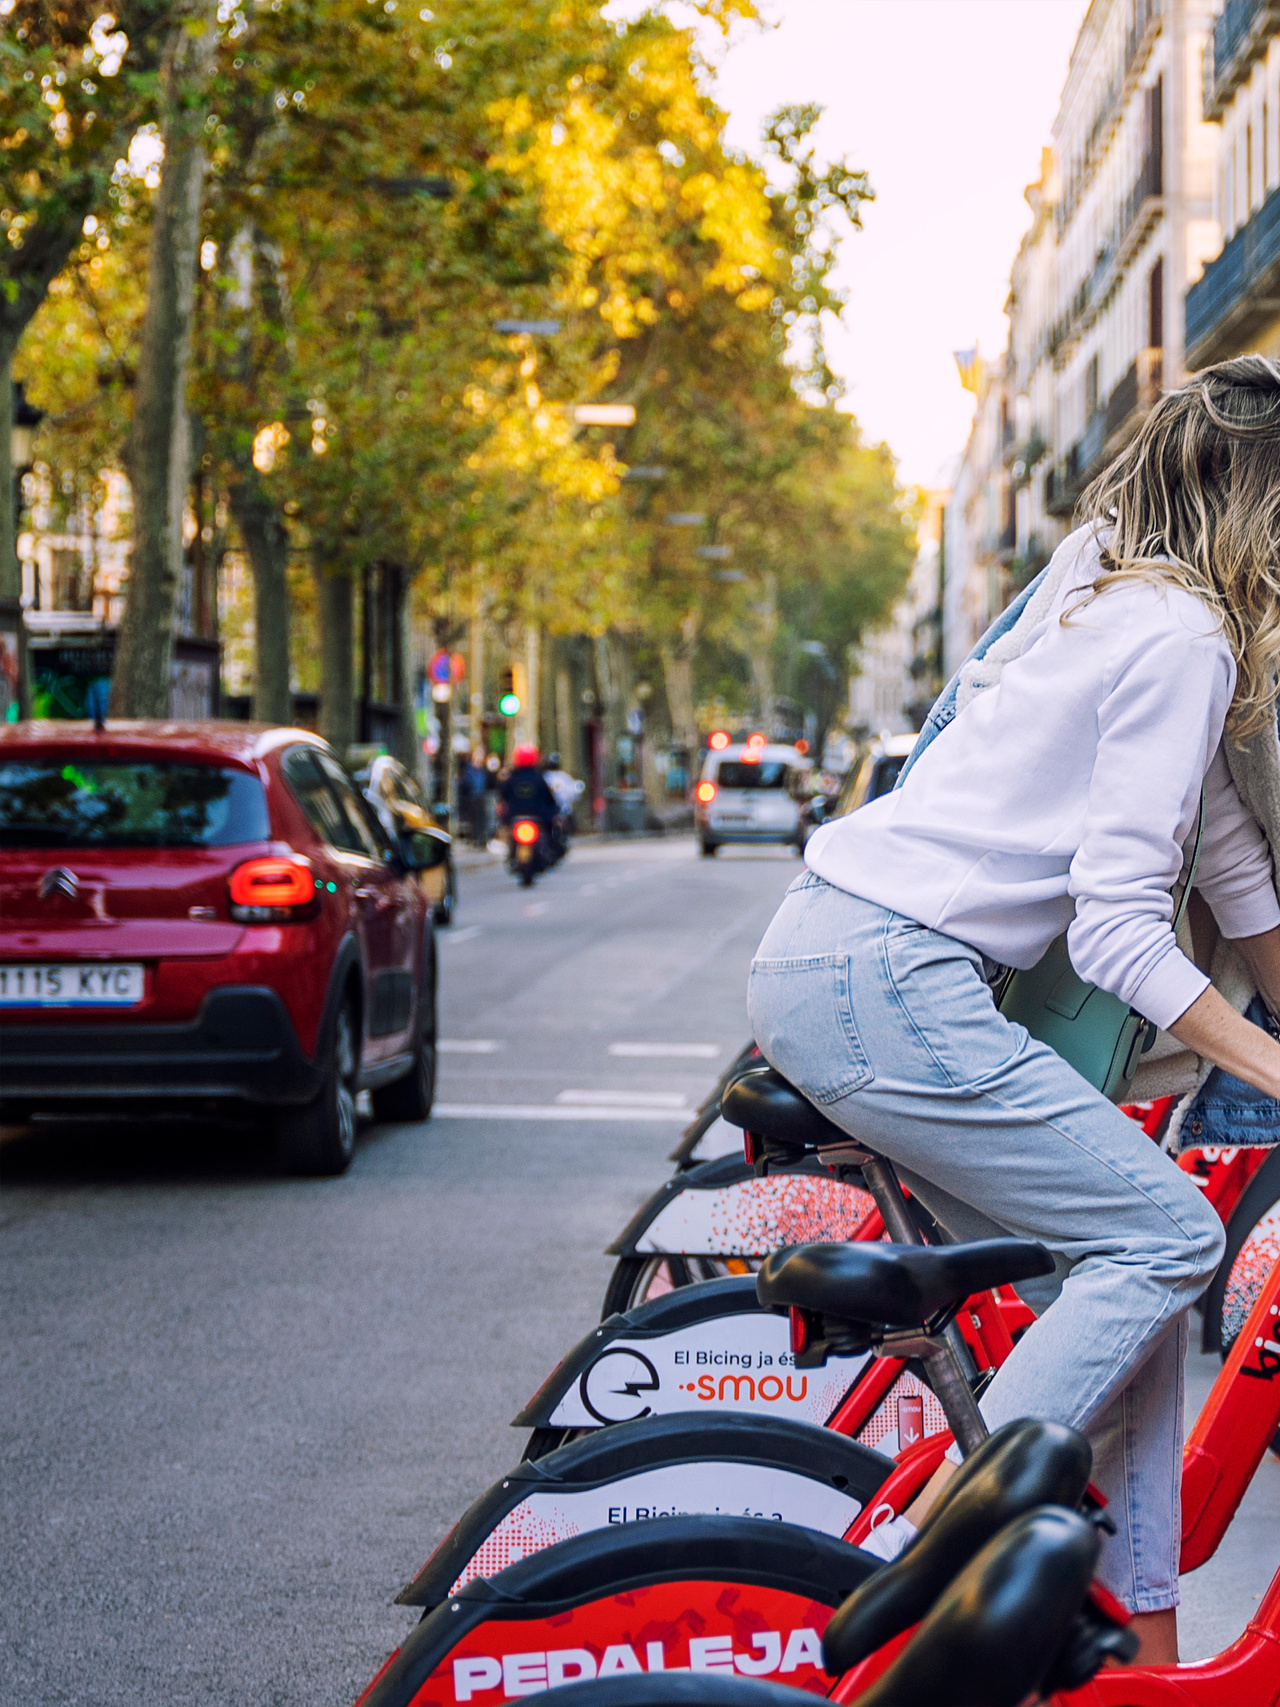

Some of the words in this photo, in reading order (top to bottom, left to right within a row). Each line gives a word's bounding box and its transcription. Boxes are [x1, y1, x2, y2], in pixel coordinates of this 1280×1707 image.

[0, 968, 62, 995] 1115
[78, 968, 130, 995] KYC
[674, 1350, 690, 1365] El
[696, 1350, 752, 1369] Bicing
[757, 1351, 773, 1369] ja
[778, 1351, 797, 1366] és
[697, 1375, 807, 1401] smou
[608, 1506, 627, 1524] El
[453, 1627, 824, 1702] PEDALEJA
